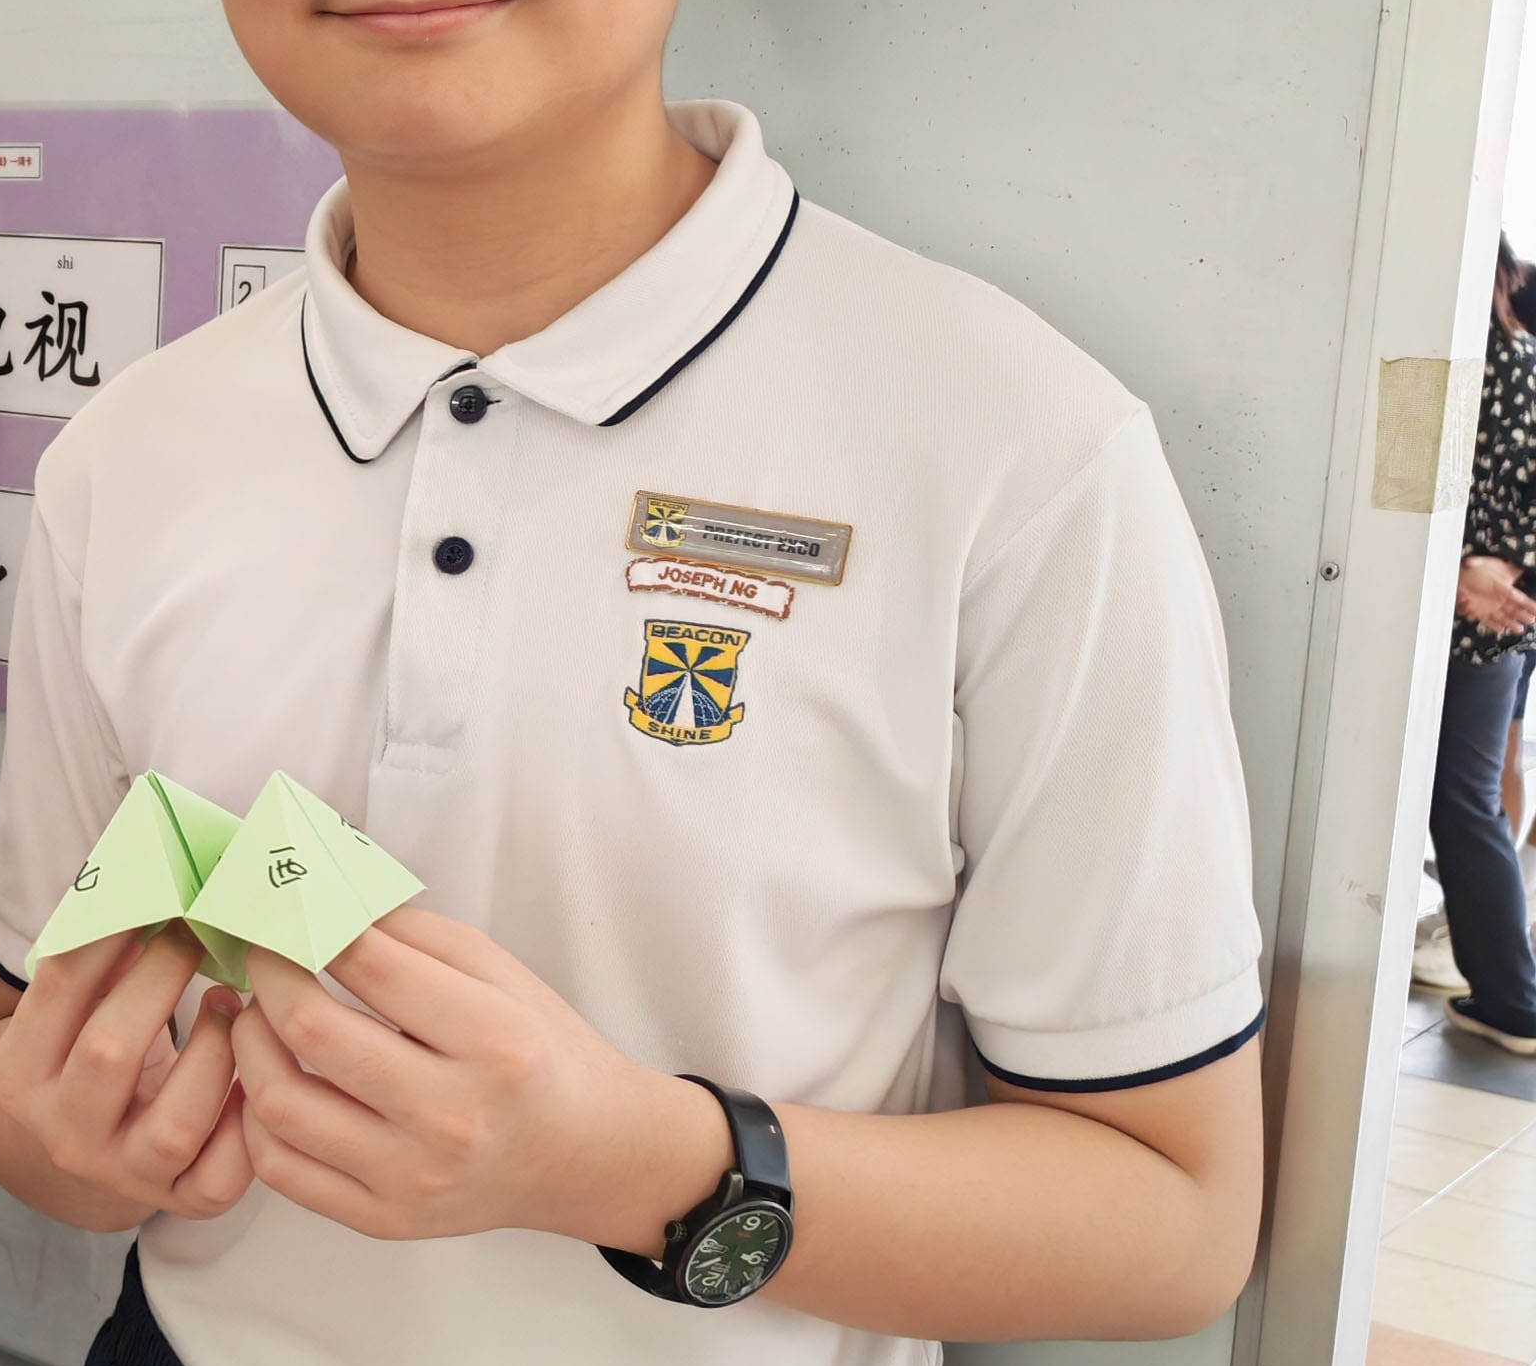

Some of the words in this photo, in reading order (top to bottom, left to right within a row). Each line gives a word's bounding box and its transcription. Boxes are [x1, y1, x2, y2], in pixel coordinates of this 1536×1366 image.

[703, 524, 775, 549] PREFECT
[777, 536, 821, 558] EXCO
[658, 566, 727, 591] JOSEPH
[729, 579, 759, 599] NG
[650, 624, 741, 646] BEACON
[647, 721, 713, 740] SHINE
[268, 845, 308, 889] 西
